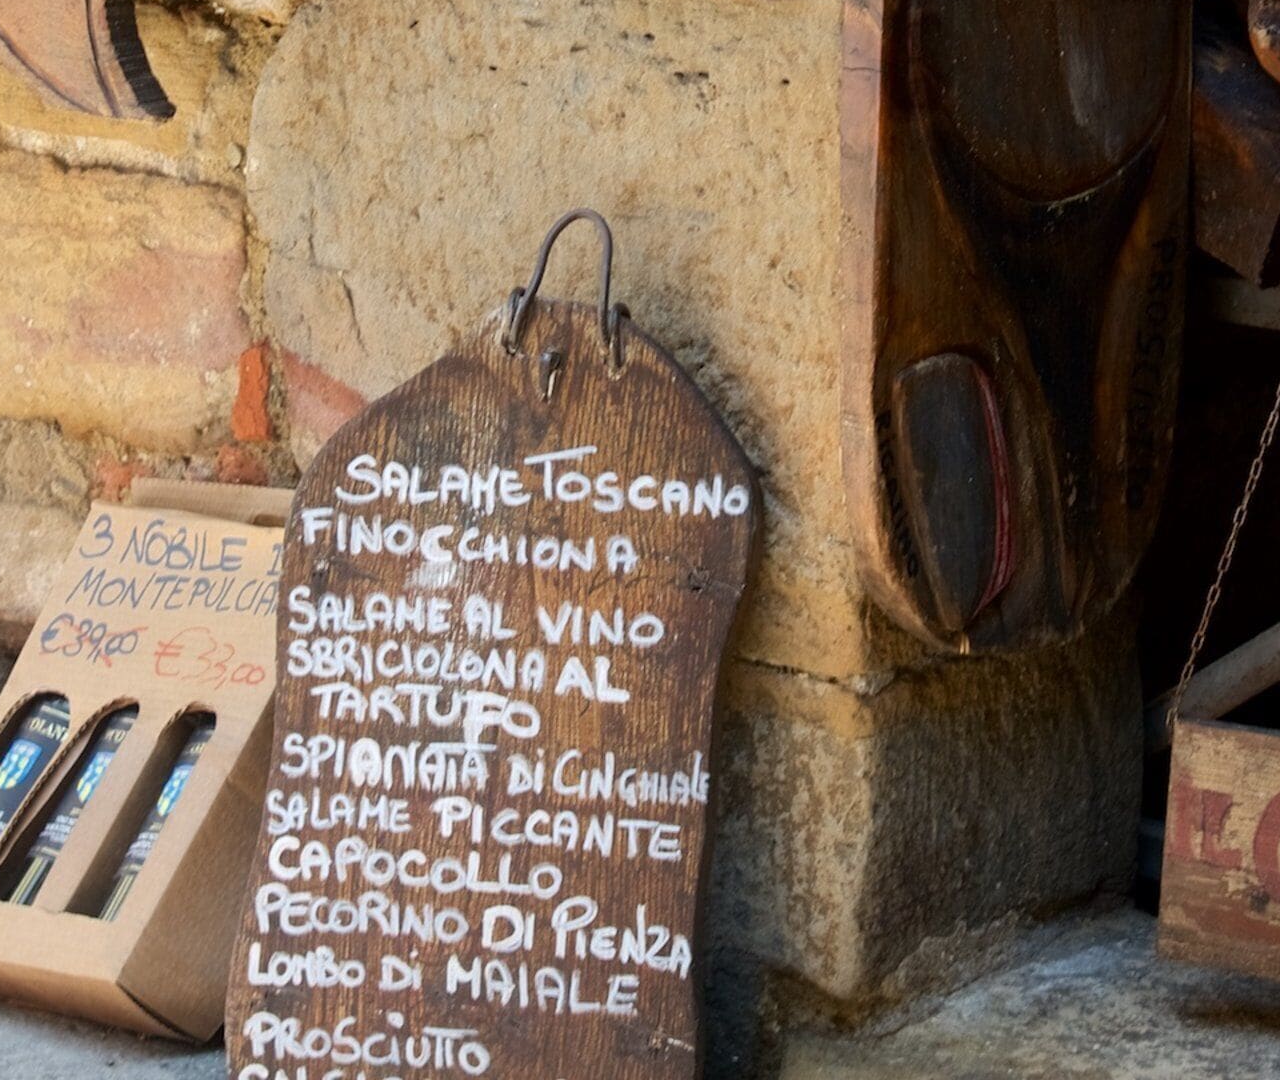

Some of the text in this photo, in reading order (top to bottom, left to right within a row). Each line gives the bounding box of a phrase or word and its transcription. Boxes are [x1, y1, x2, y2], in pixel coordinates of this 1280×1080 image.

[335, 446, 749, 518] SALAME TOSCANO
[79, 513, 115, 558] 3
[119, 519, 247, 571] NOBILE
[301, 506, 637, 575] FINOCCHIONA
[65, 566, 282, 617] MONTEPULCIA
[287, 585, 665, 648] SALAME AL VINO
[287, 638, 630, 704] SBRICIOLONA AL
[310, 681, 540, 743] TARTUFO
[280, 732, 497, 793] SPIANATA
[267, 788, 683, 862] SALAME PICCANTE
[268, 835, 563, 900] CAPOCOLLO
[255, 882, 693, 980] PECORINO DI PIENZA
[248, 941, 366, 990] LOMBO
[446, 954, 640, 1016] MAIALE
